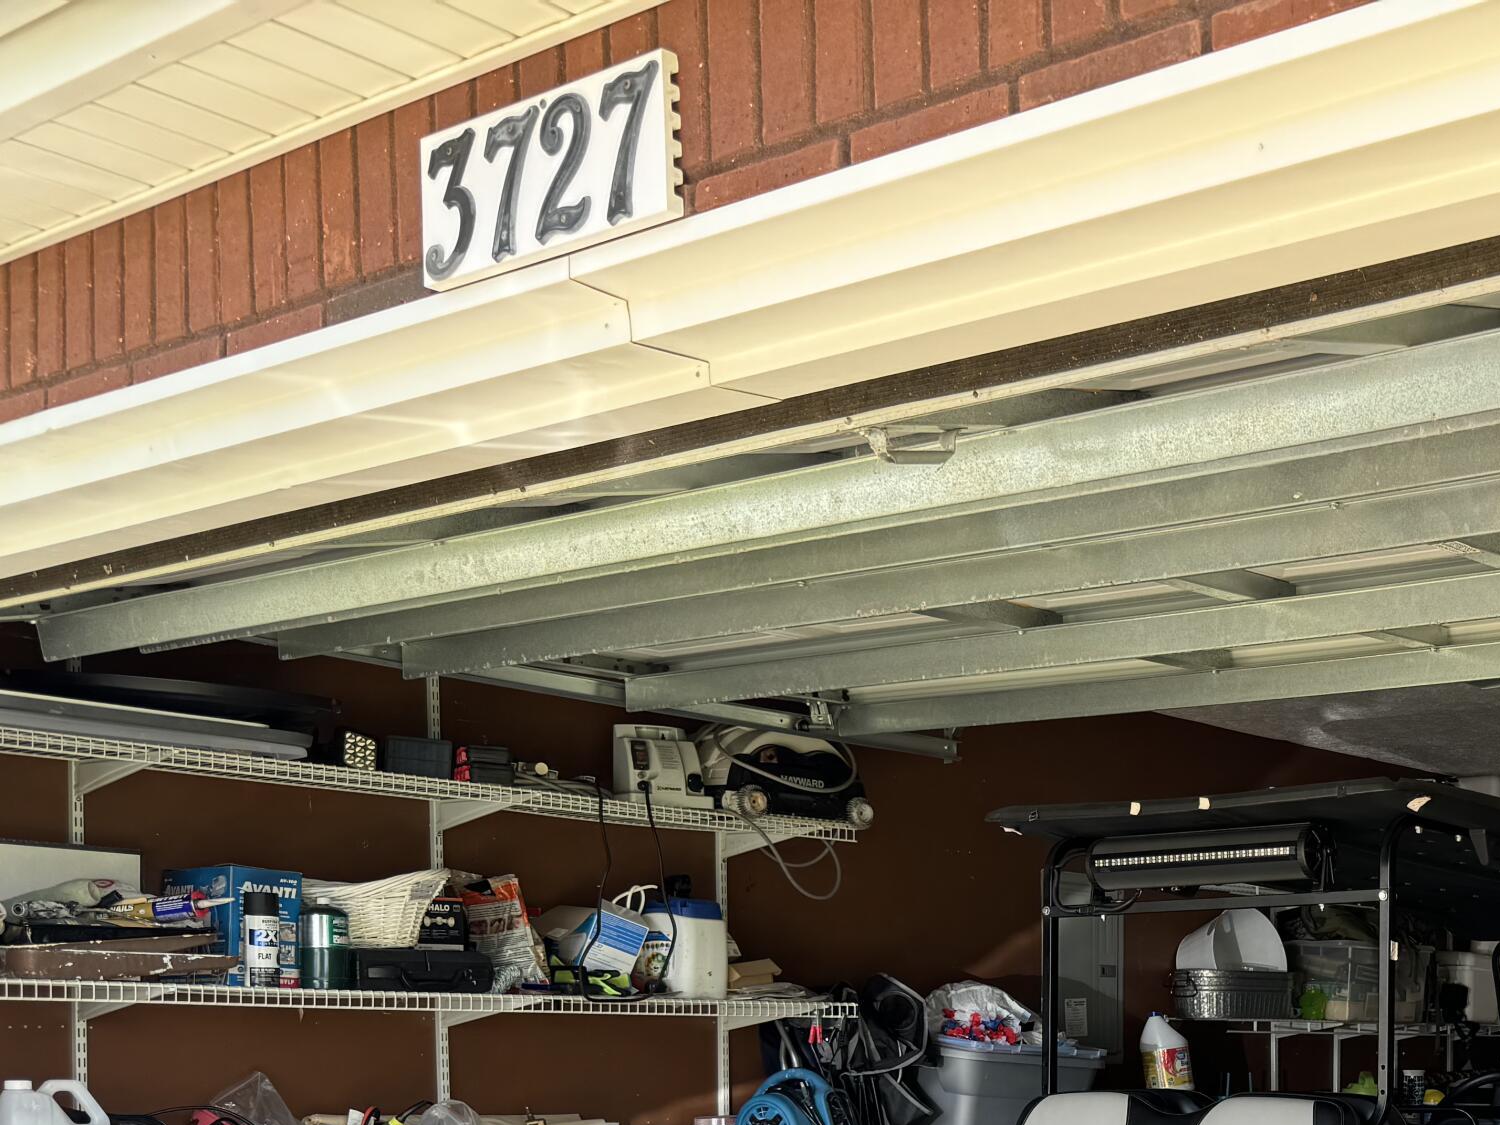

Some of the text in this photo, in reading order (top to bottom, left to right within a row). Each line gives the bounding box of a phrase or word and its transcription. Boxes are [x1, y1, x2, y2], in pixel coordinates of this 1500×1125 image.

[425, 59, 659, 281] 3727
[239, 881, 297, 899] AVANTI
[428, 903, 450, 912] HALO
[256, 929, 278, 943] 2X
